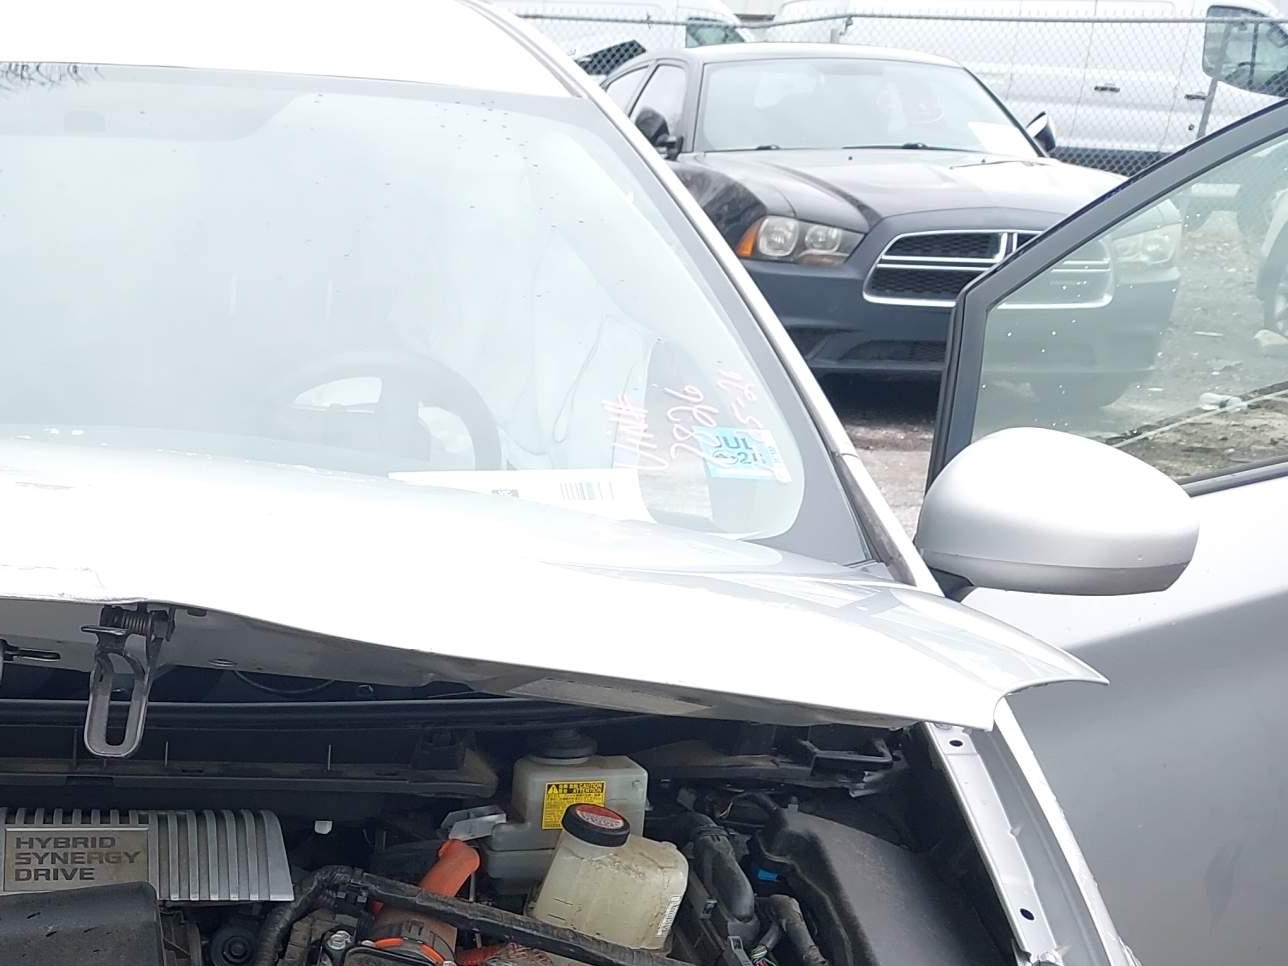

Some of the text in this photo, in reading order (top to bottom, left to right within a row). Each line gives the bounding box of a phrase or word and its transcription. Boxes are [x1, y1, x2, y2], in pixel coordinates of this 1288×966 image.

[712, 435, 753, 450] JUL
[15, 836, 116, 849] HYBRID
[14, 850, 142, 865] SYNERGY
[14, 867, 95, 881] DRIVE
